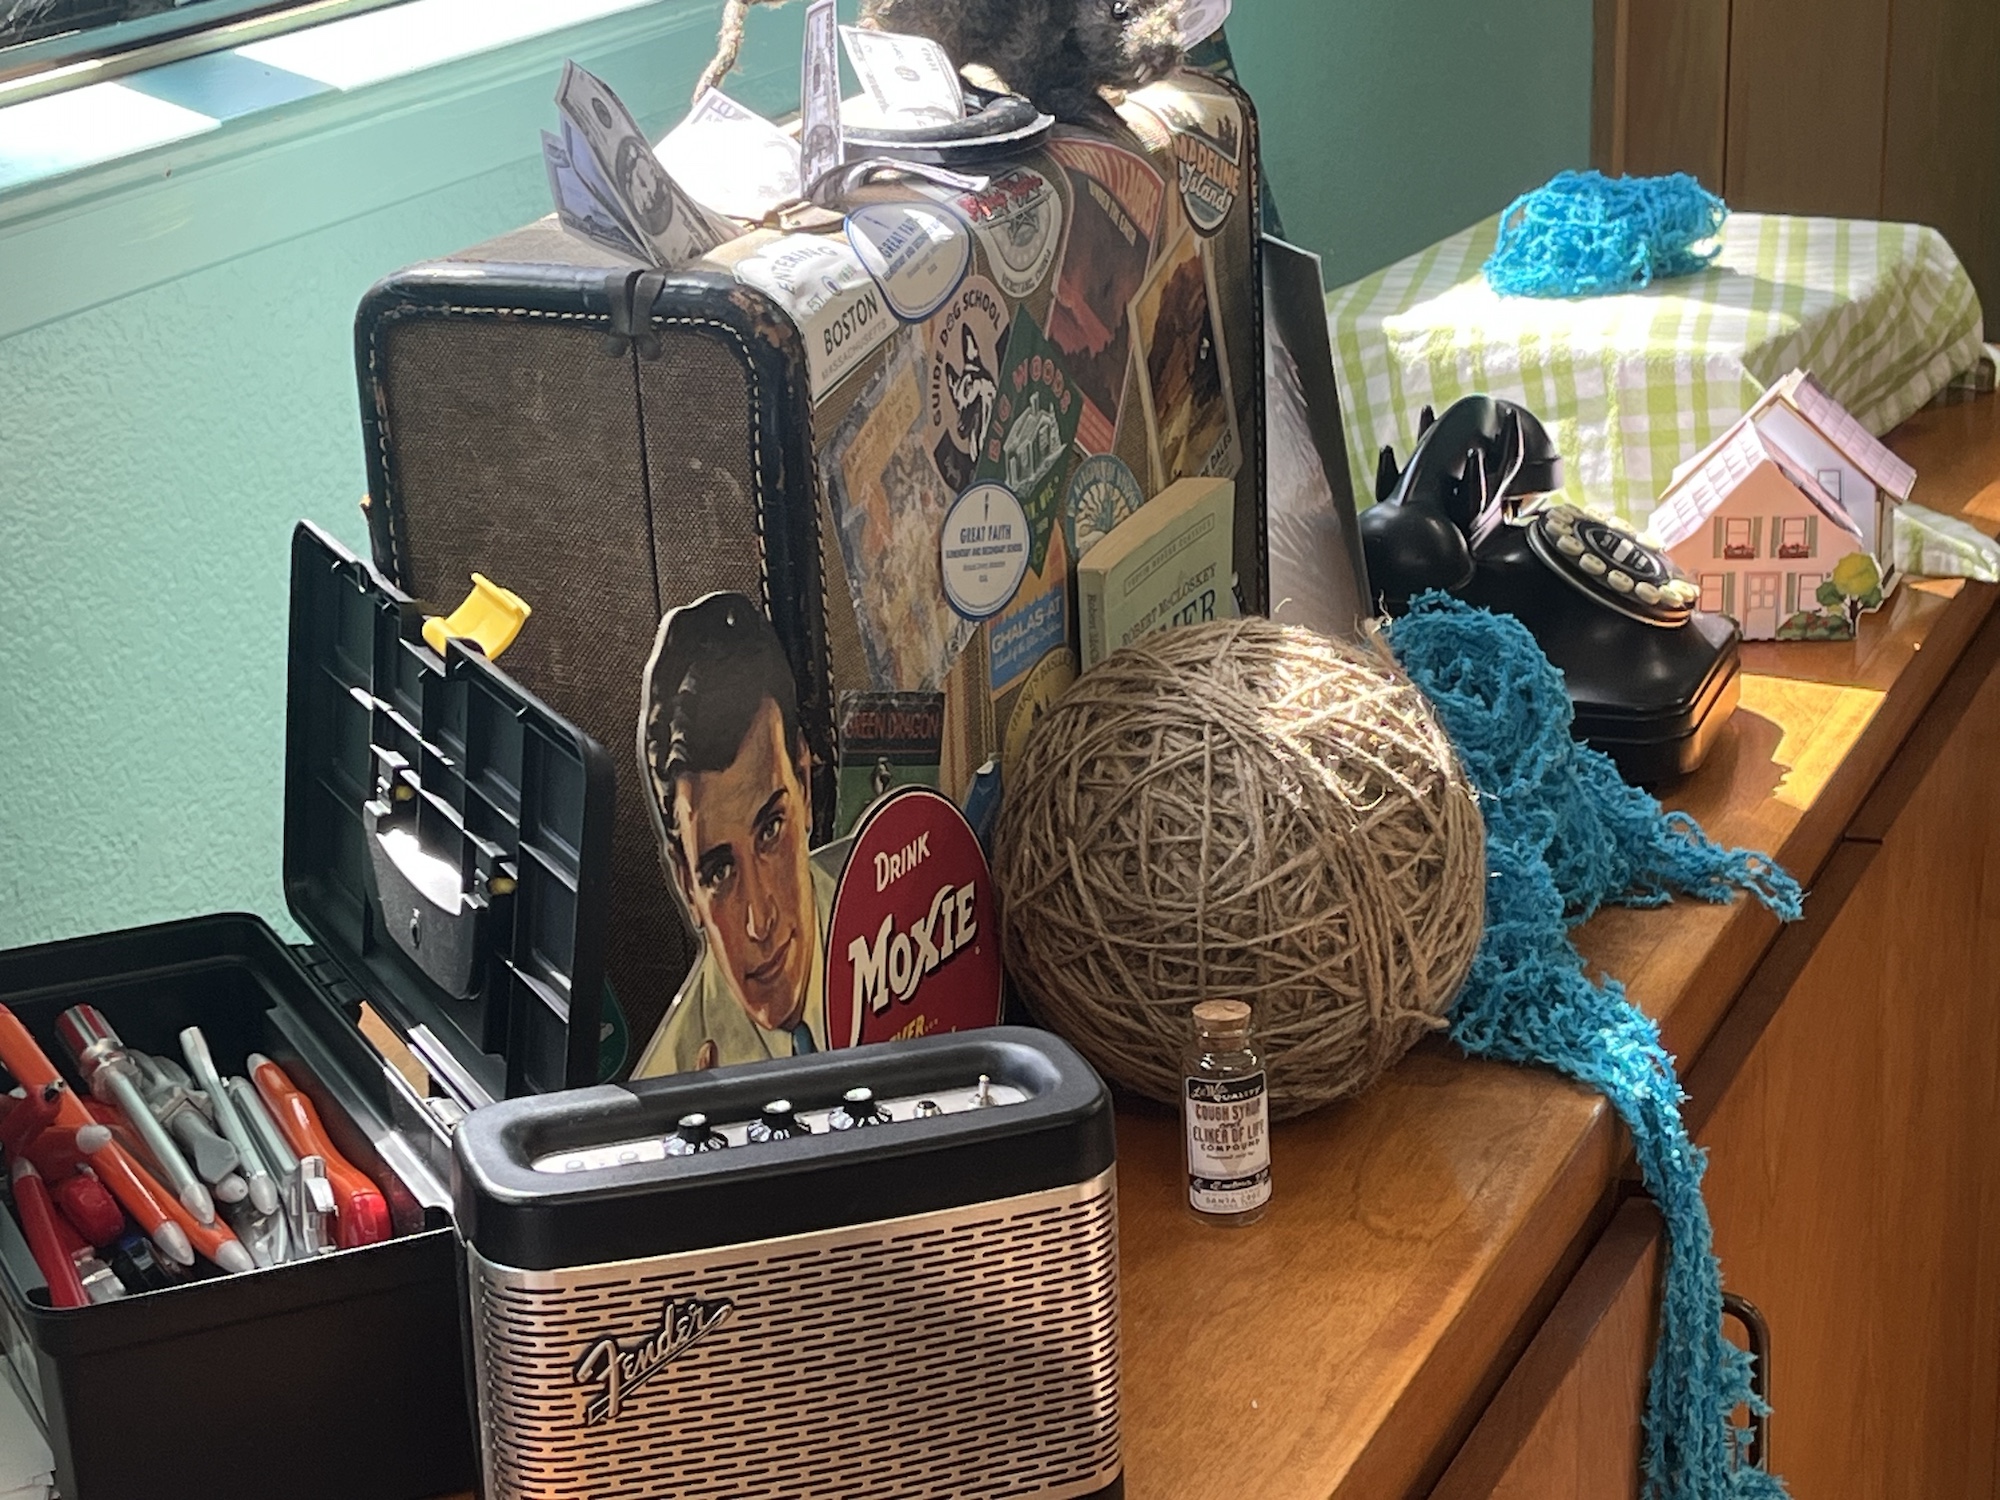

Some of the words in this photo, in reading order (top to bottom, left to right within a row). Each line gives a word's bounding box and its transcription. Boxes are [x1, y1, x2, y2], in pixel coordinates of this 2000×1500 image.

[1175, 134, 1241, 197] MADELINE
[878, 231, 908, 258] GREAT
[770, 245, 839, 295] ENTERING
[823, 288, 879, 357] BOSTON
[822, 318, 888, 379] MASSACHUSETTS
[932, 350, 944, 427] GUIDE
[940, 301, 961, 348] DOG
[963, 290, 1001, 331] SCHOOL
[1013, 355, 1071, 414] WOODS
[960, 526, 986, 544] GREAT
[988, 524, 1012, 541] FAITH
[991, 595, 1062, 655] GHALAS-AT
[1120, 606, 1157, 646] ROBERT
[844, 711, 885, 740] GREEN
[887, 711, 940, 740] DRAGON
[874, 831, 931, 893] DRINK
[848, 880, 977, 1048] MOXIE
[1196, 1103, 1229, 1120] COUGH
[1232, 1098, 1260, 1120] SYRUP
[1213, 1084, 1262, 1102] QUALITY
[1201, 1138, 1260, 1152] COMPOUND
[1232, 1126, 1244, 1143] OF
[1247, 1119, 1264, 1140] LIFE
[1205, 1195, 1237, 1205] SANTA
[575, 1302, 733, 1421] Fender
